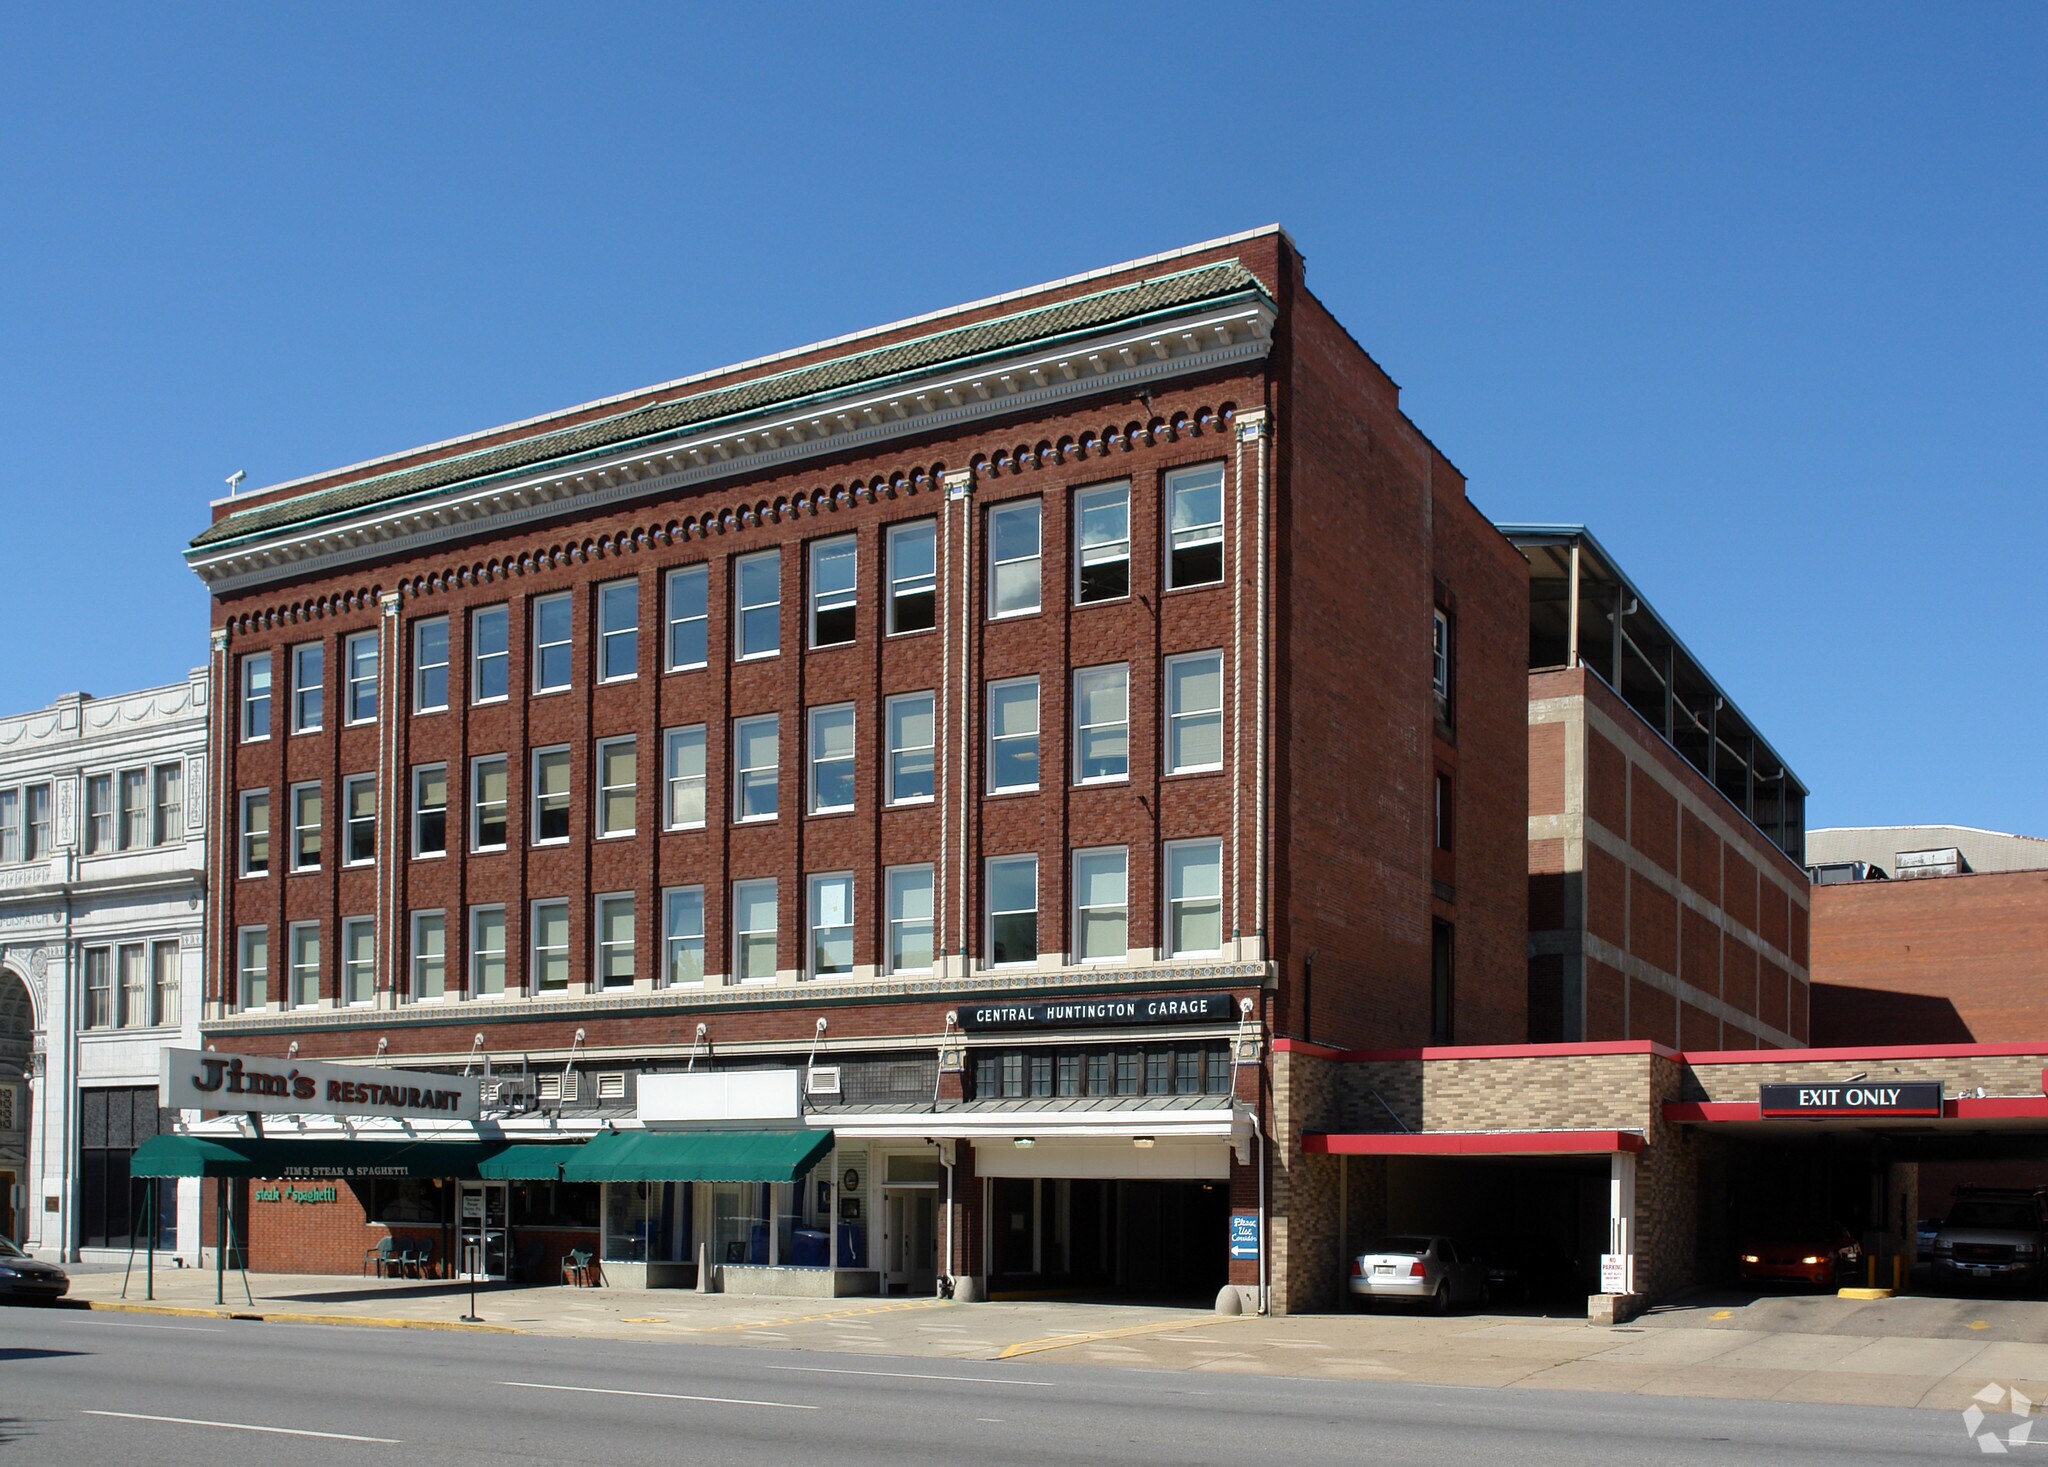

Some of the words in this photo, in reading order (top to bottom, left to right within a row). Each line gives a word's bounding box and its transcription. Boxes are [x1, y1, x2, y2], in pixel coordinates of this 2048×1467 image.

[976, 1008, 1035, 1022] CENTRAL
[1047, 1003, 1135, 1019] HUNTINGTON
[1148, 1000, 1208, 1015] GARAGE
[192, 1058, 316, 1100] Jim's
[326, 1079, 462, 1111] RESTAURANT
[1799, 1089, 1840, 1106] EXIT
[1845, 1088, 1901, 1106] ONLY
[284, 1167, 310, 1176] JIM'S
[312, 1167, 345, 1176] STEAK
[346, 1167, 354, 1176] &
[356, 1166, 409, 1176] SPAGHETTI
[255, 1186, 280, 1201] steak
[292, 1186, 336, 1204] spaghetti
